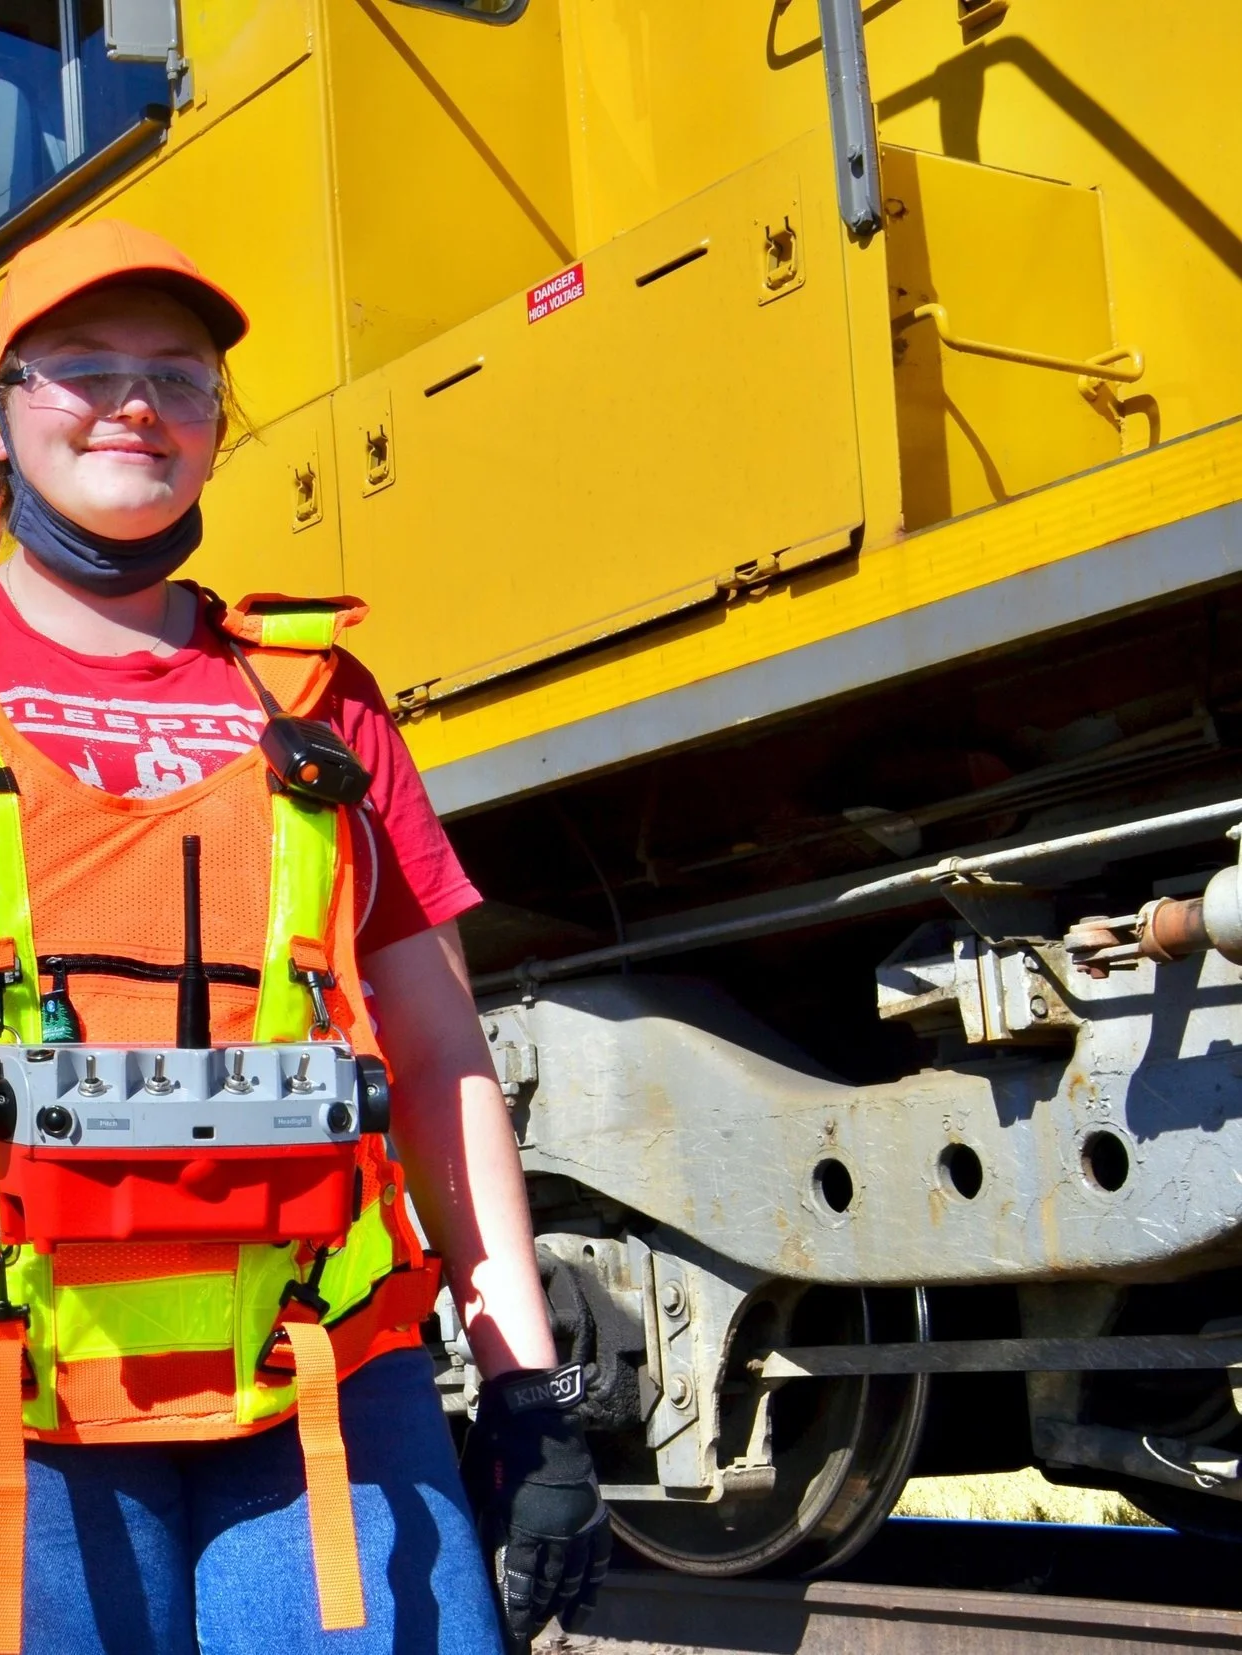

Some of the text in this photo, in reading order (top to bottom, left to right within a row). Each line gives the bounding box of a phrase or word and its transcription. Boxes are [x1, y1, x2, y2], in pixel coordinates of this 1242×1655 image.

[528, 283, 583, 322] HIGH VOLTAGE
[534, 271, 575, 303] DANGER
[514, 1378, 571, 1406] KINCO
